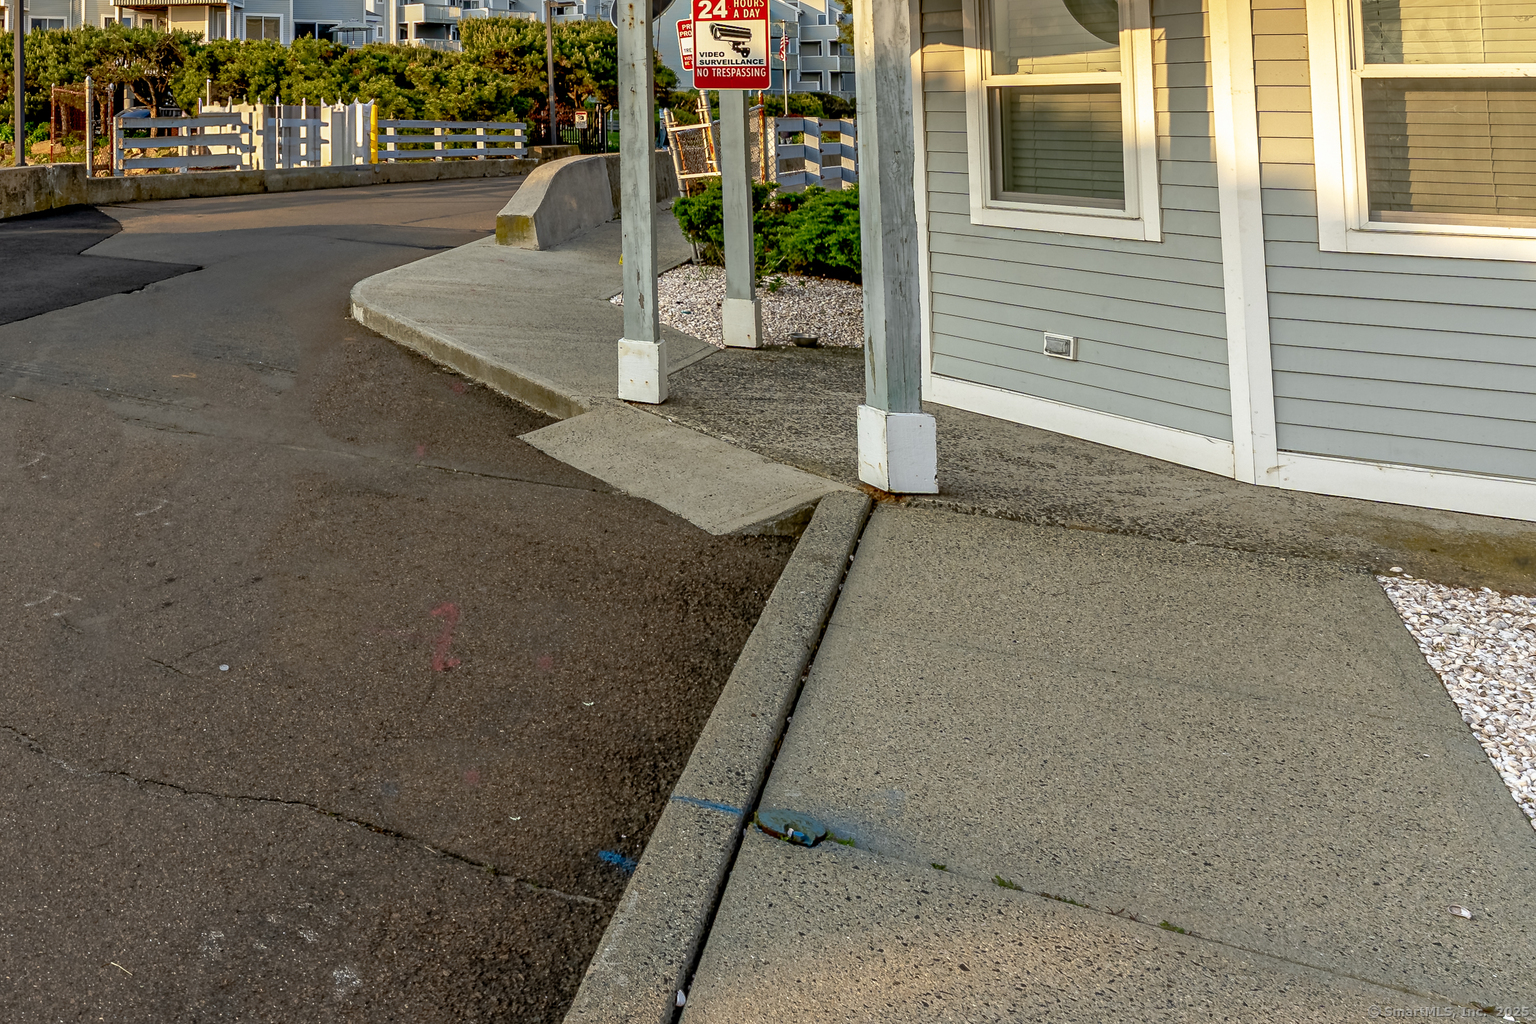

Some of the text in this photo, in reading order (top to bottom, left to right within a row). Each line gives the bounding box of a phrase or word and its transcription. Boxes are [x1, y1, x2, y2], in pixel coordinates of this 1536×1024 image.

[698, 0, 728, 18] 24
[733, 9, 760, 18] A DAY
[696, 68, 766, 77] NO TRESPASSING
